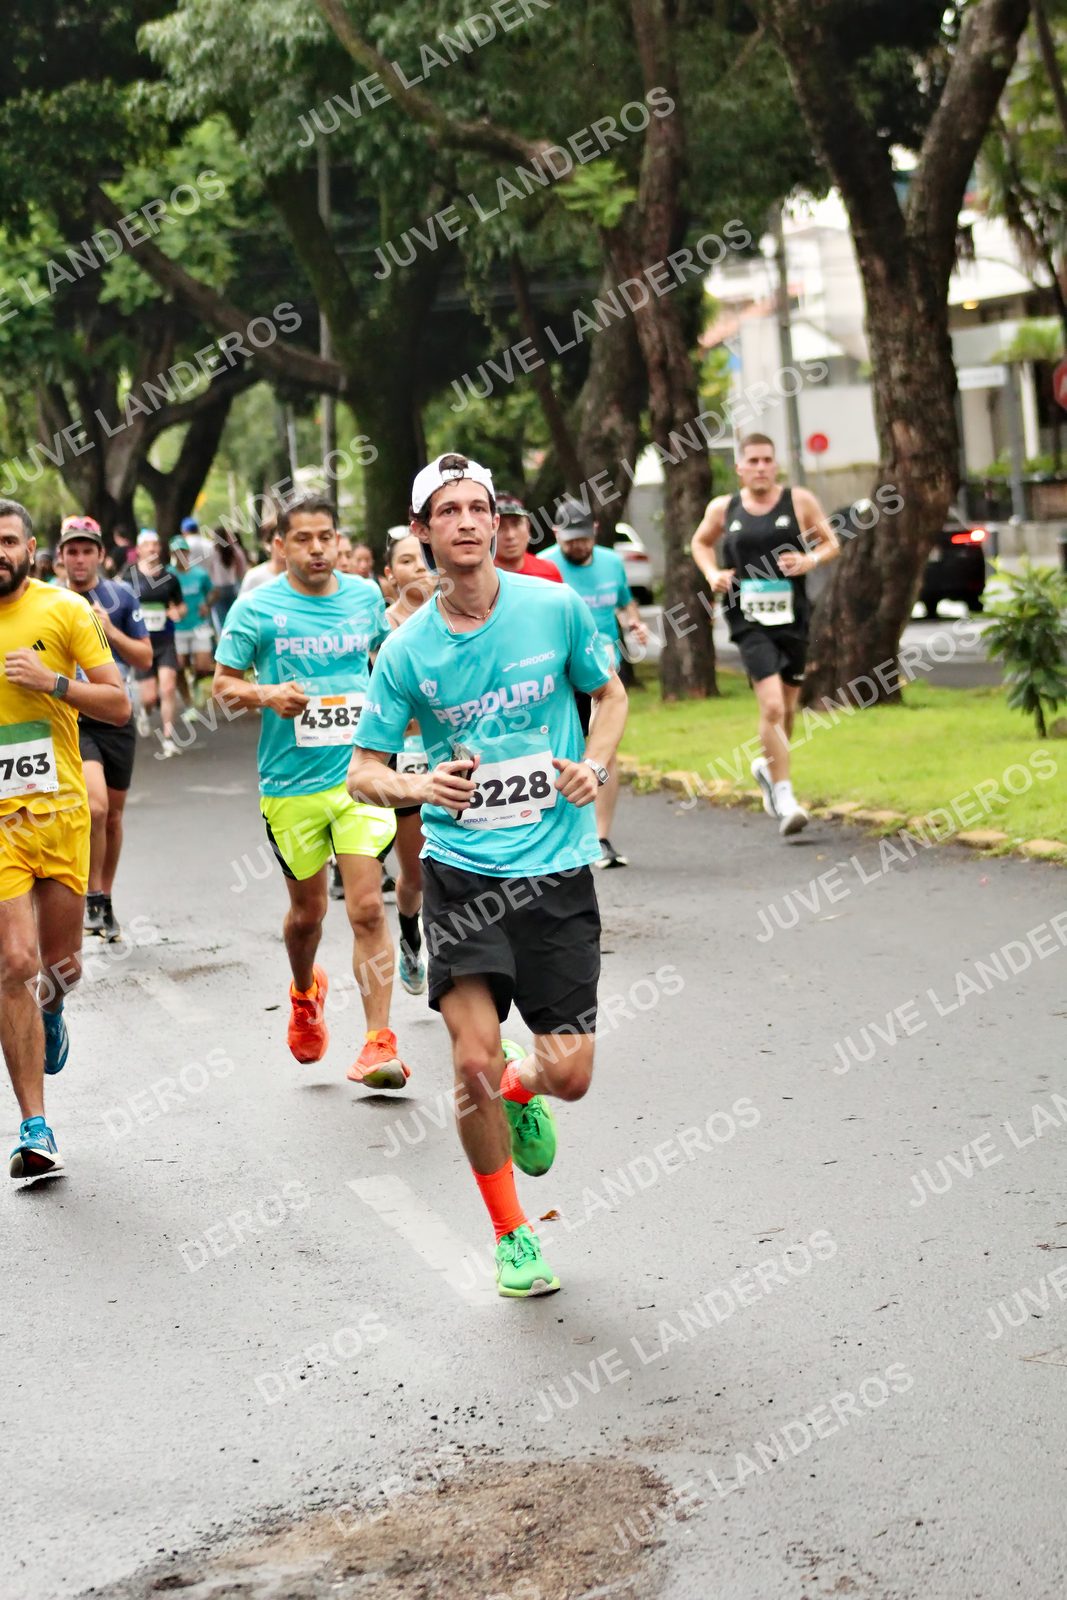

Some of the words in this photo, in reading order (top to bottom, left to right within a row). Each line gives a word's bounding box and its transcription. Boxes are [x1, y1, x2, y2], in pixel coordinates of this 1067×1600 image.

[519, 650, 556, 668] BROOKS
[432, 674, 556, 727] PERDURA
[301, 706, 363, 730] 4383
[0, 752, 51, 781] 763
[468, 770, 551, 809] 6228
